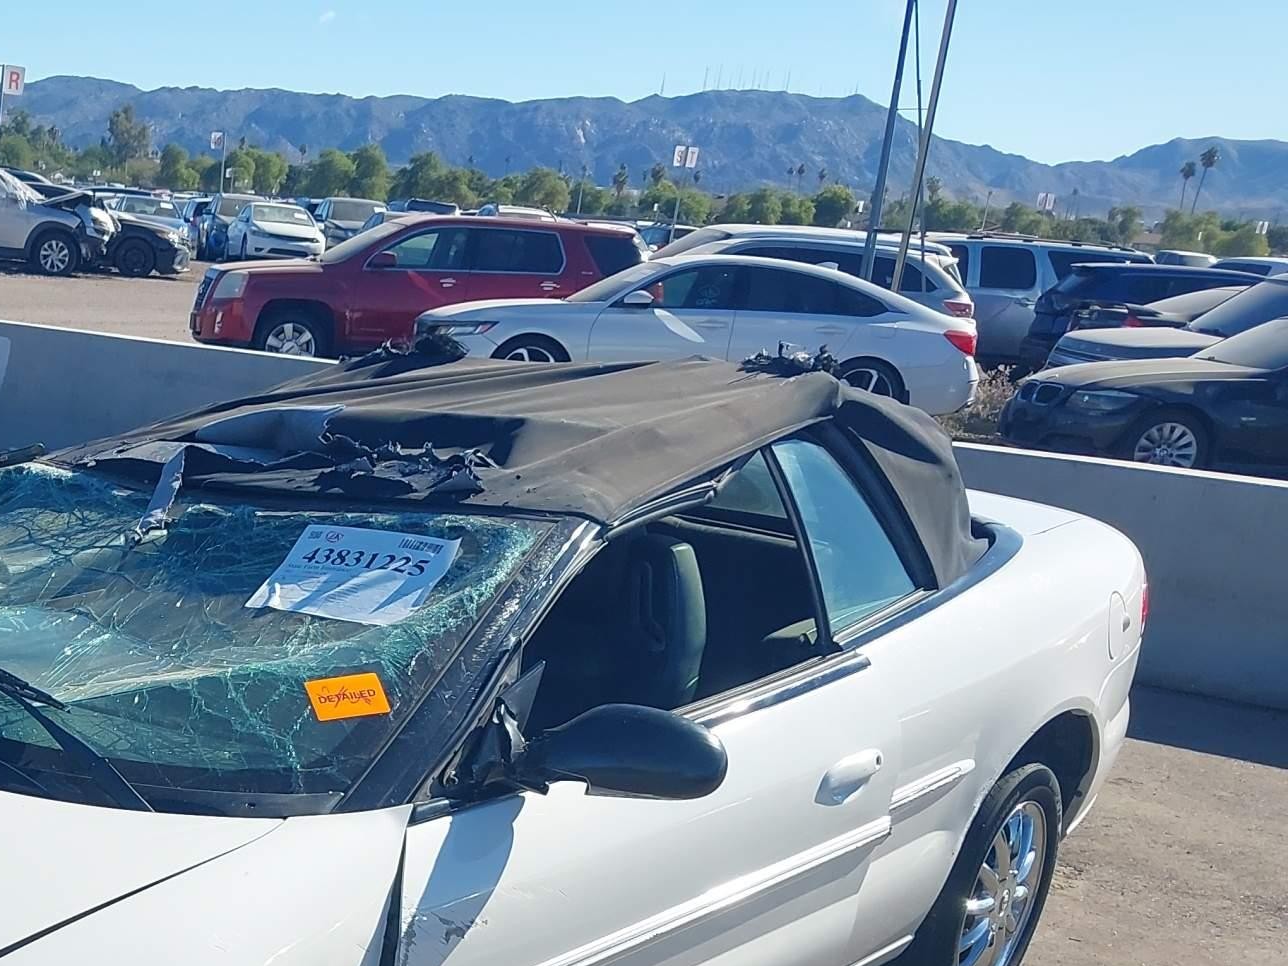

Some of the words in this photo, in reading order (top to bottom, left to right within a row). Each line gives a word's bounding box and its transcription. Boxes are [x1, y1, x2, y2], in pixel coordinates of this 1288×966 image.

[8, 71, 20, 90] R
[302, 546, 430, 577] 43831225
[317, 688, 376, 705] DETAILED
